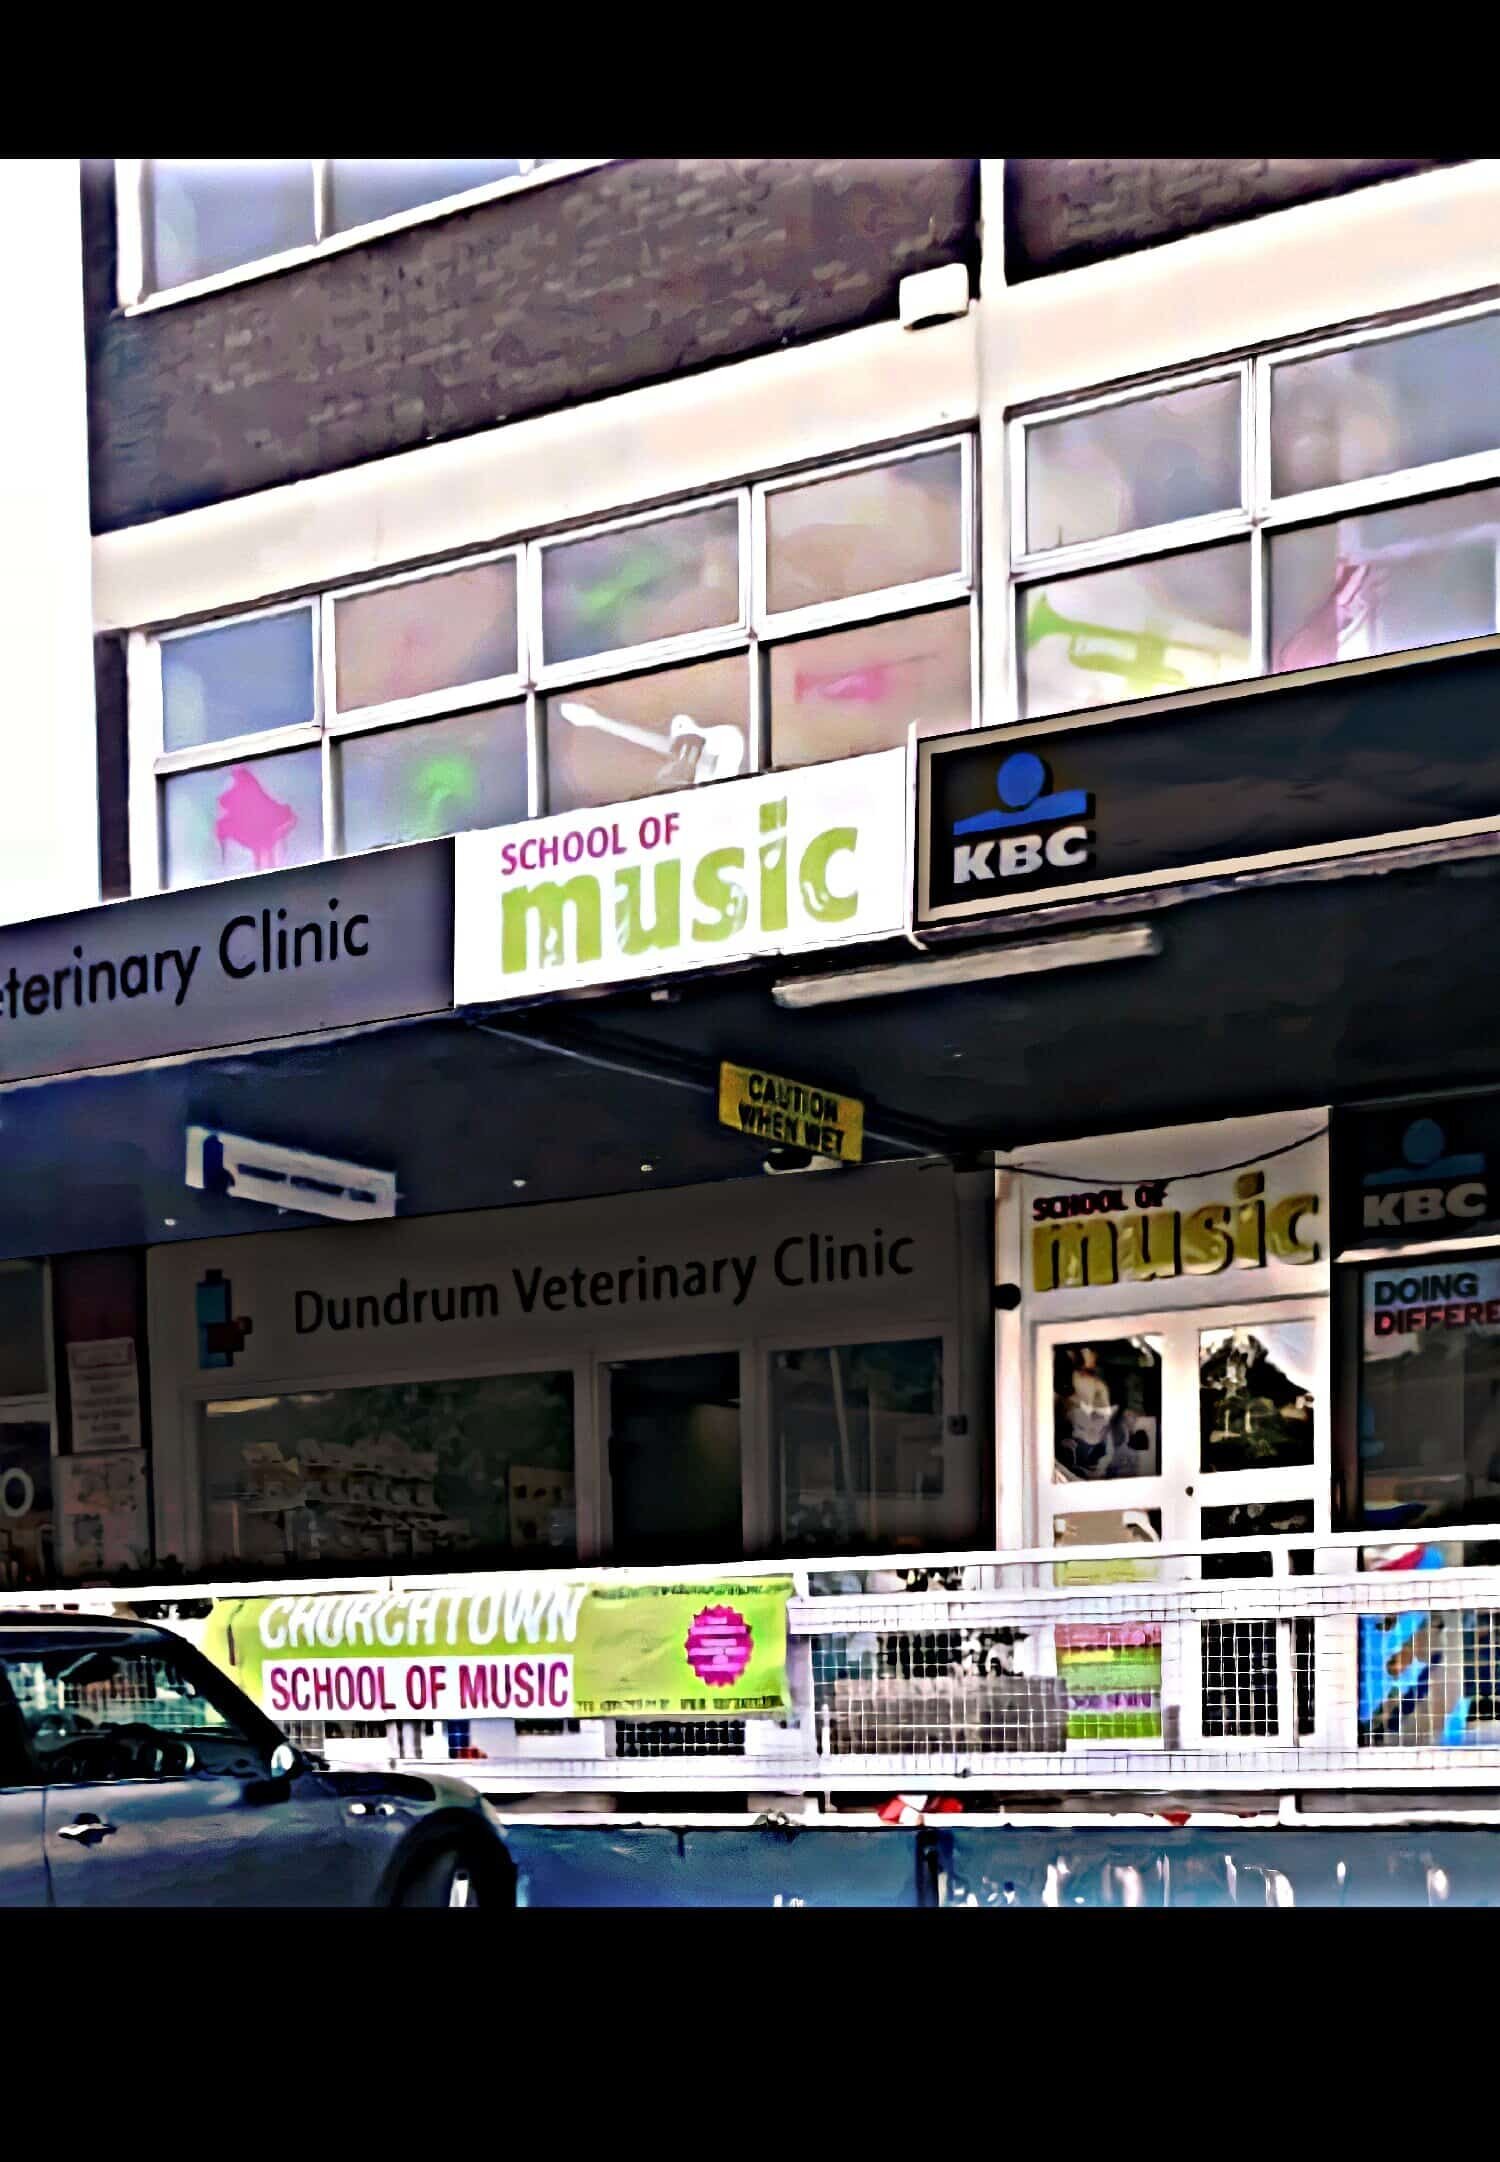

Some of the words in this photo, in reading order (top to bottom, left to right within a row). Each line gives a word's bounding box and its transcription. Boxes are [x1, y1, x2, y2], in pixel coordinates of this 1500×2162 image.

[501, 823, 627, 876] SCHOOL
[639, 812, 680, 850] OF
[953, 826, 1088, 884] KBC
[502, 796, 859, 974] music
[0, 945, 201, 1019] terinary
[219, 898, 369, 979] Clinic
[749, 1073, 839, 1122] CAUTION
[738, 1099, 799, 1143] WHEN
[804, 1121, 845, 1155] WET
[1033, 1189, 1128, 1221] SCHOOL
[1134, 1182, 1168, 1208] OF
[1363, 1182, 1487, 1228] KBC
[1033, 1170, 1322, 1292] music
[295, 1277, 499, 1334] Dundrum
[512, 1256, 757, 1313] Veterinary
[774, 1228, 914, 1287] Clinic
[1374, 1272, 1479, 1305] DOING
[258, 1585, 586, 1649] CHURCHTOWN
[270, 1666, 397, 1710] SCHOOL
[406, 1665, 447, 1710] OF
[459, 1662, 569, 1709] MUSIC
